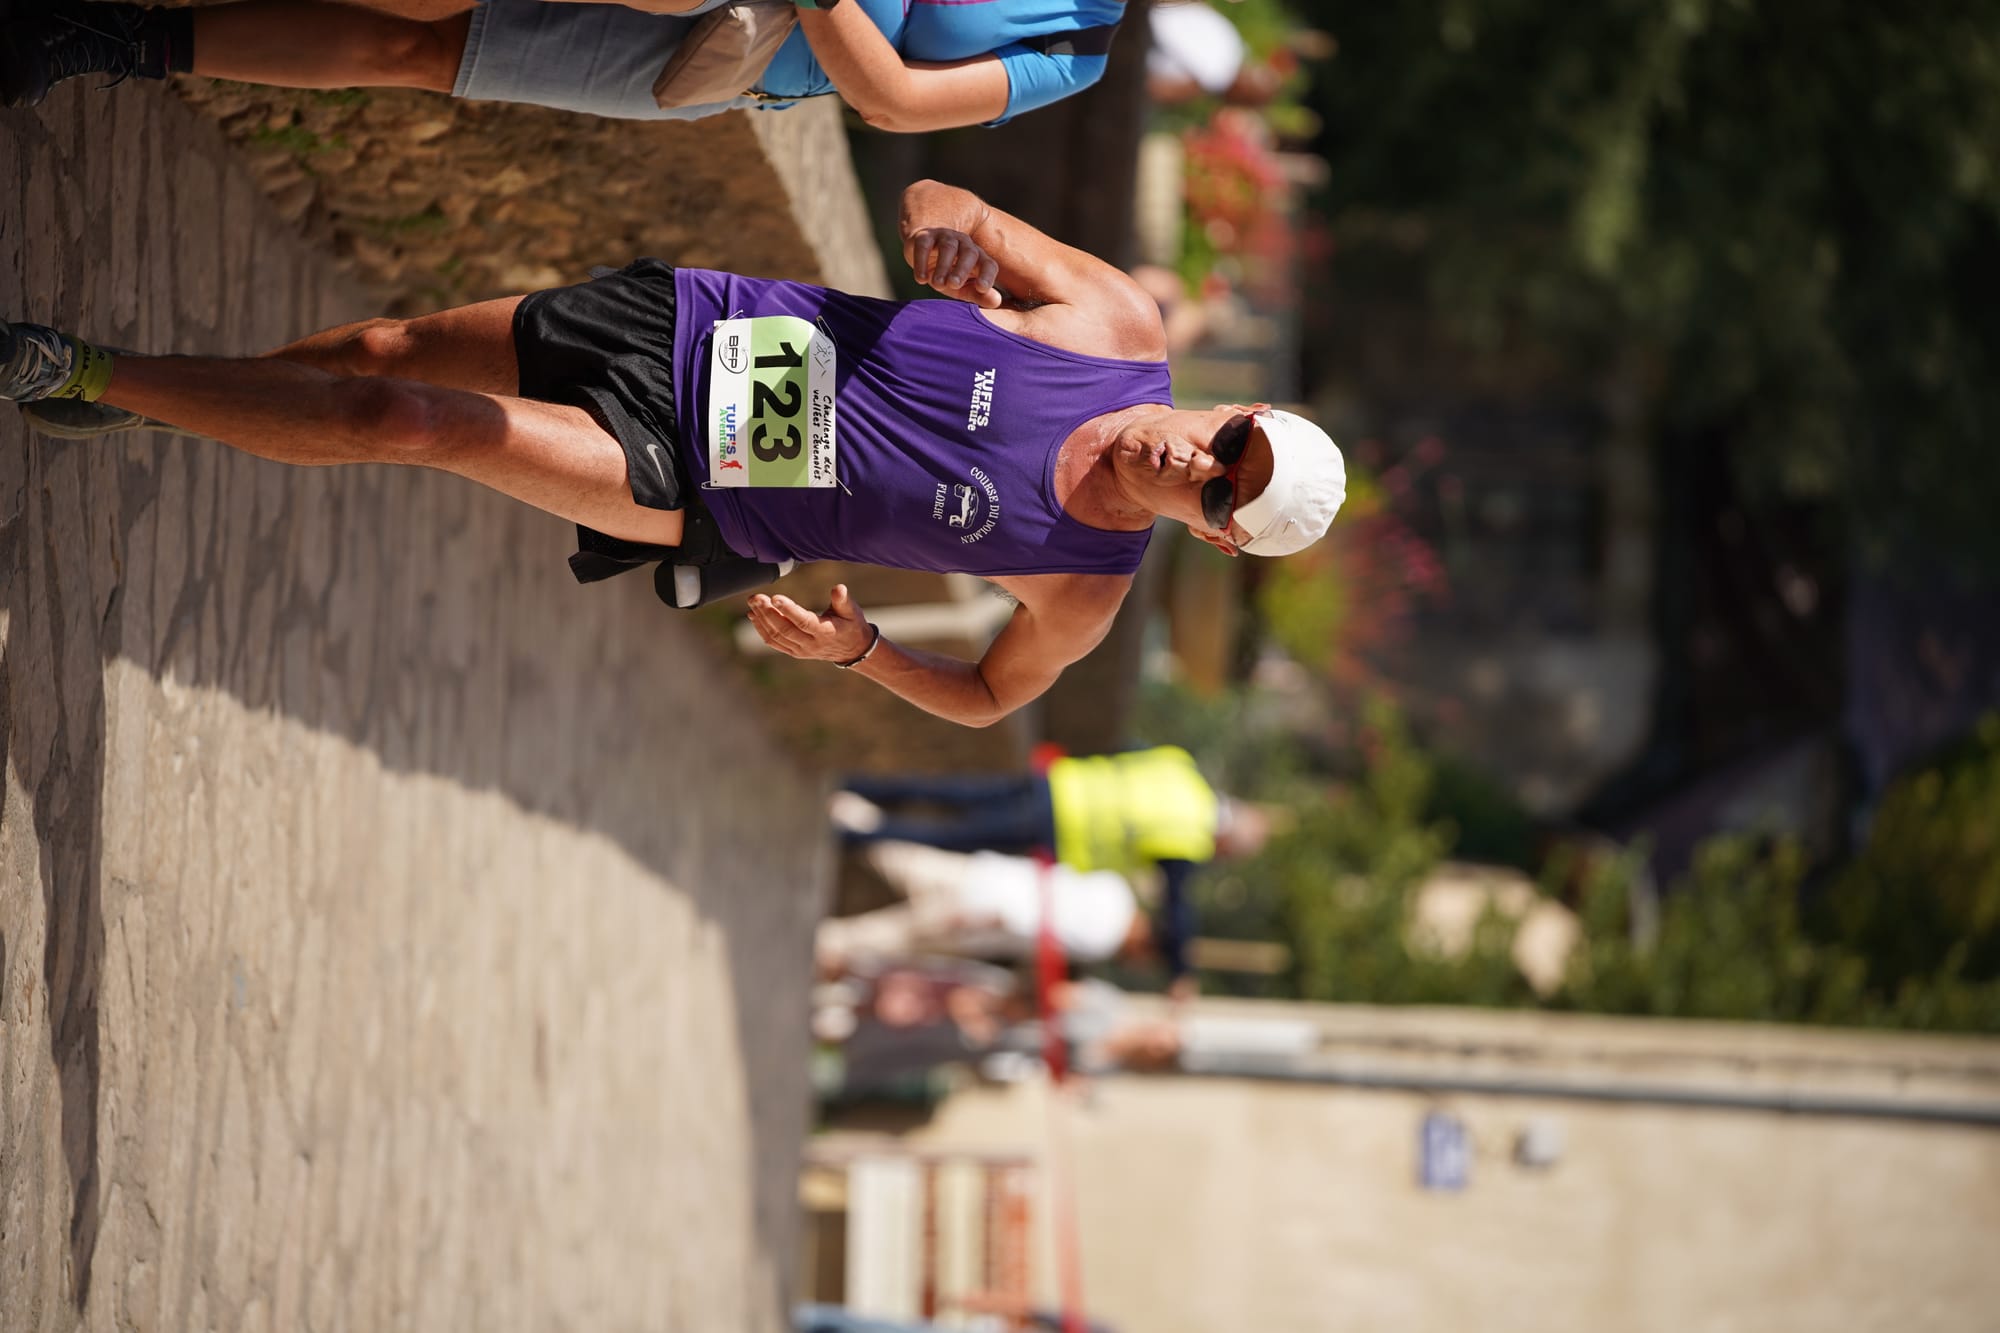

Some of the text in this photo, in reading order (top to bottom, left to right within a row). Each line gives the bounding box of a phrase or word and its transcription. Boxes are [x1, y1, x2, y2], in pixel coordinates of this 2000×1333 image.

[728, 335, 739, 369] BFP
[751, 341, 803, 463] 123
[967, 372, 986, 432] Aventure
[977, 368, 996, 427] TUFF'S
[719, 408, 729, 460] Aventure
[726, 403, 736, 455] TUFF'S
[813, 389, 822, 480] vallées cévenoles
[821, 395, 832, 475] Challenge des
[932, 482, 948, 520] FLORAC
[960, 466, 1000, 545] COURSE DU DOLMEN
